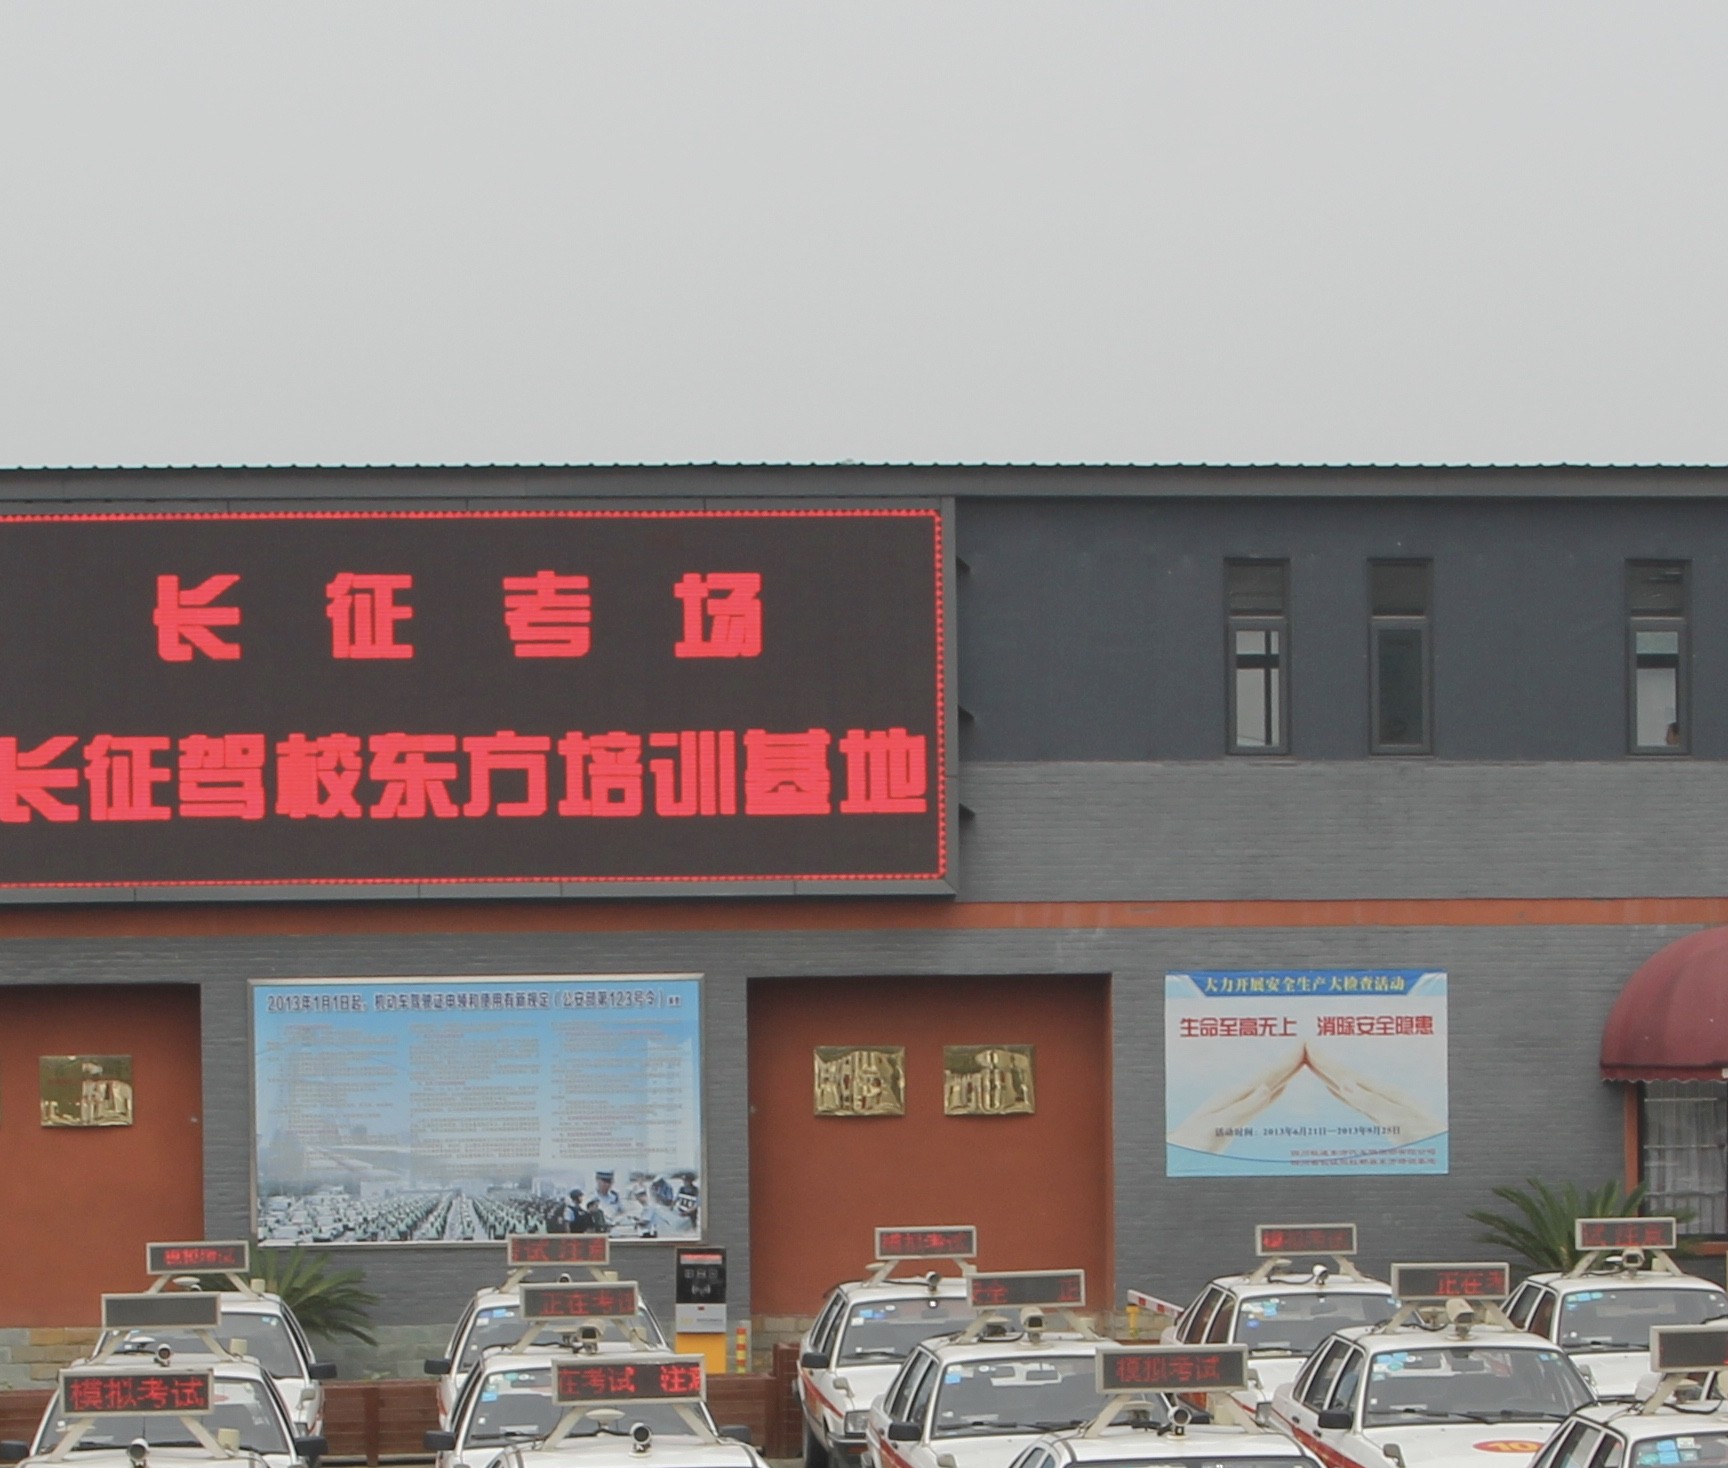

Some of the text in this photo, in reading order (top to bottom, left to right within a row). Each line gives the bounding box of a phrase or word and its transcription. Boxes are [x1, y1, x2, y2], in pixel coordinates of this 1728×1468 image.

[154, 571, 761, 661] 长征考场
[1204, 975, 1406, 992] 大力开展安全生产大检查活动
[1179, 1015, 1434, 1037] 生命至高无上 消除安全隐患
[70, 1377, 205, 1410] 模拟考试
